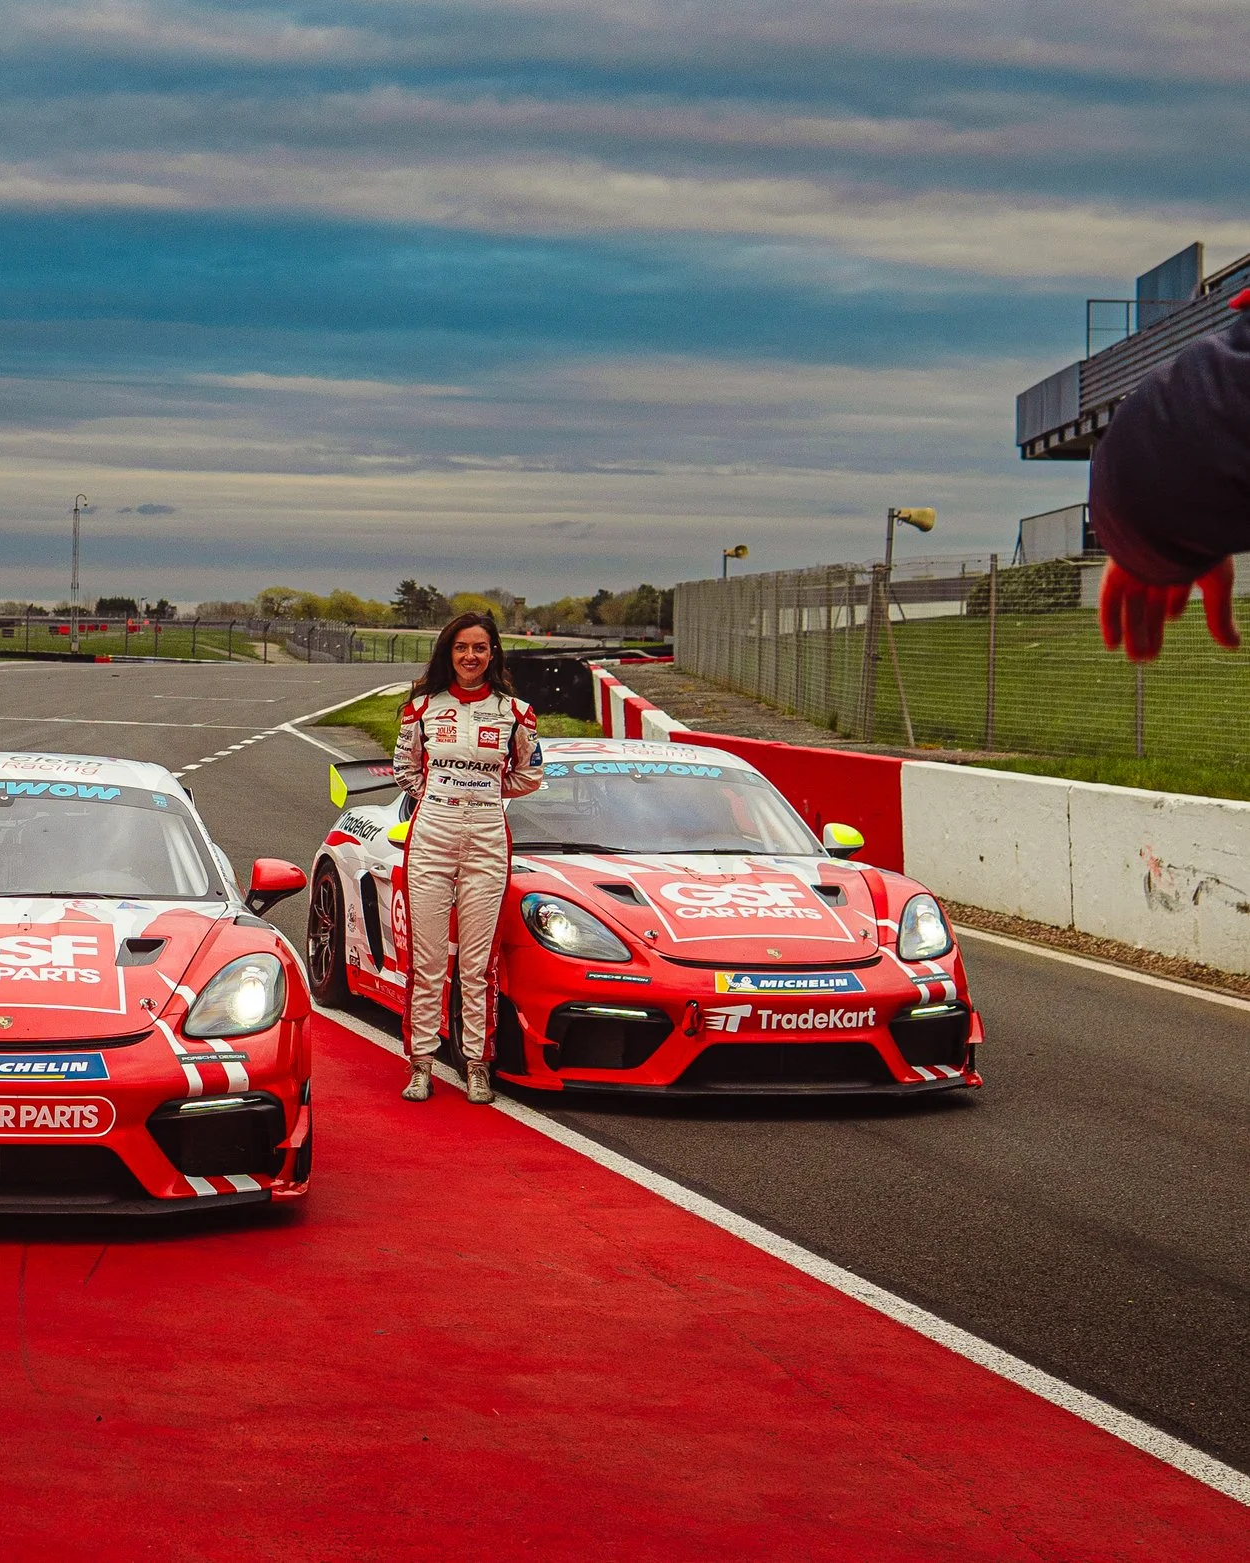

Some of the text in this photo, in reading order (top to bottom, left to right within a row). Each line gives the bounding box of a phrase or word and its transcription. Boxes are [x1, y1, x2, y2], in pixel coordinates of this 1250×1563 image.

[479, 731, 498, 740] GSF
[9, 755, 103, 766] Clean
[432, 759, 501, 772] AUTOFARM
[1, 761, 101, 776] Racing
[573, 762, 723, 778] carwow
[659, 881, 806, 907] GSF
[675, 907, 823, 920] CAR PARTS
[758, 978, 849, 988] MICHELIN
[757, 1007, 877, 1030] TradeKart
[19, 1105, 99, 1128] PARTS
